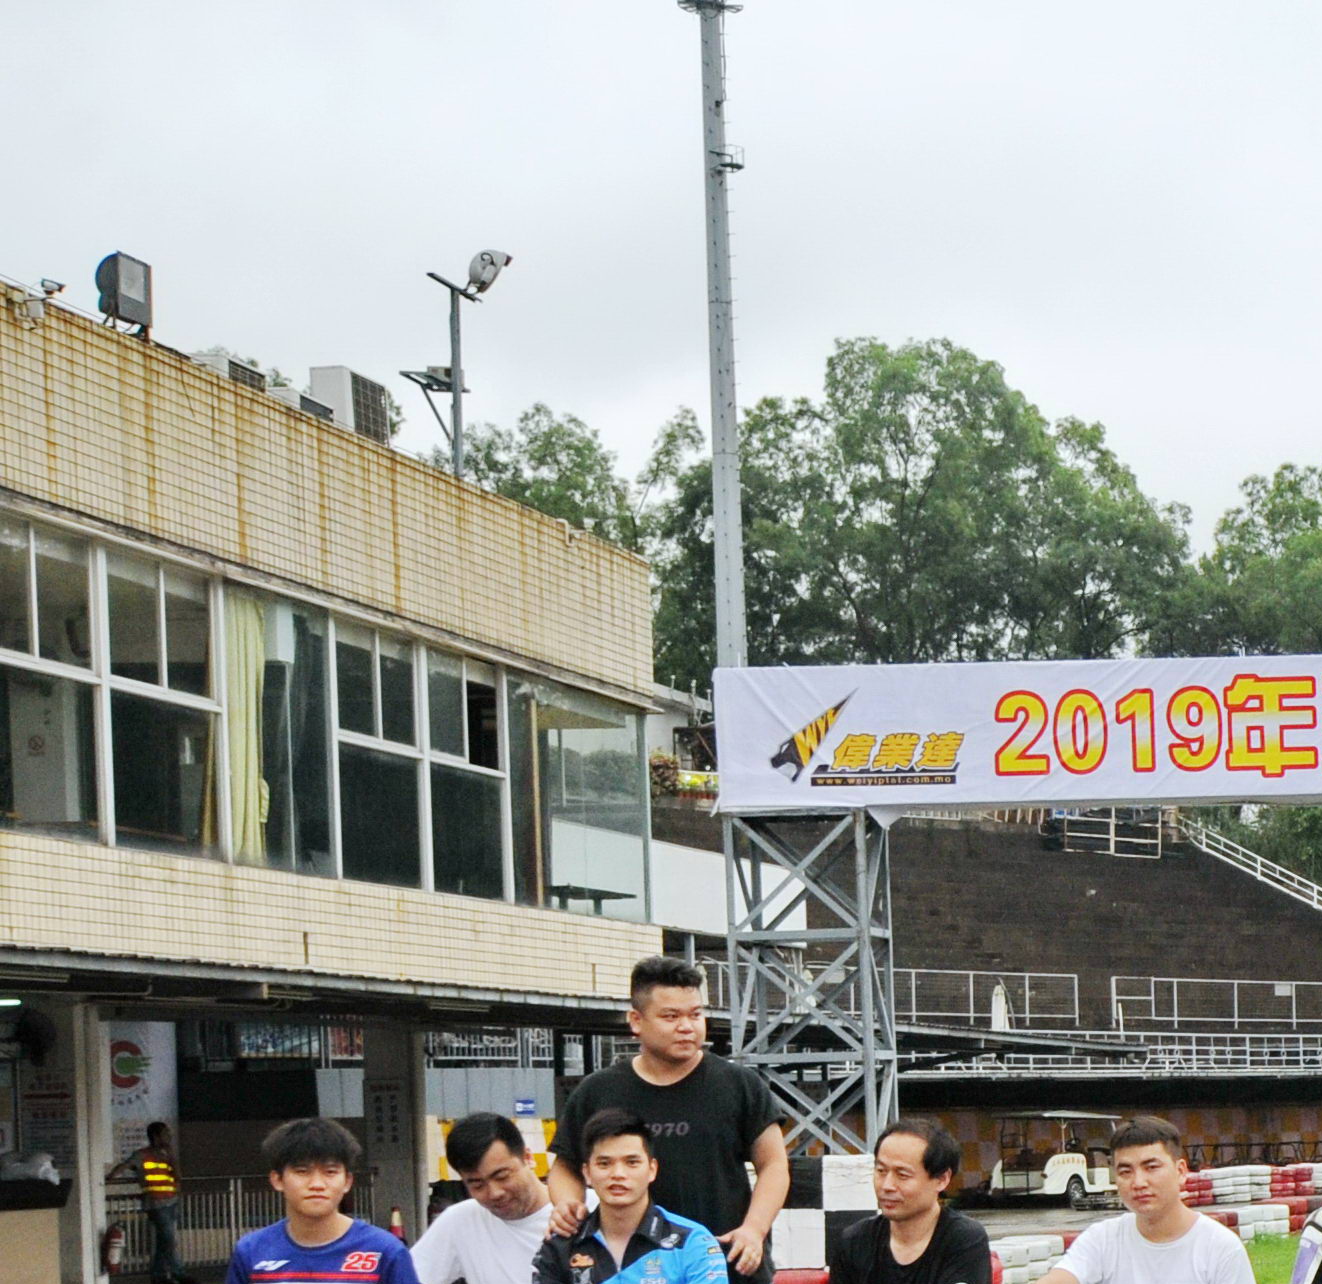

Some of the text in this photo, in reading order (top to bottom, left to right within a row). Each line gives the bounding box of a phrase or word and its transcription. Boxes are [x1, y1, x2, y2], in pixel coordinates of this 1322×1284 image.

[832, 731, 965, 770] 偉業達
[646, 1122, 690, 1136] 970
[341, 1252, 380, 1273] 25
